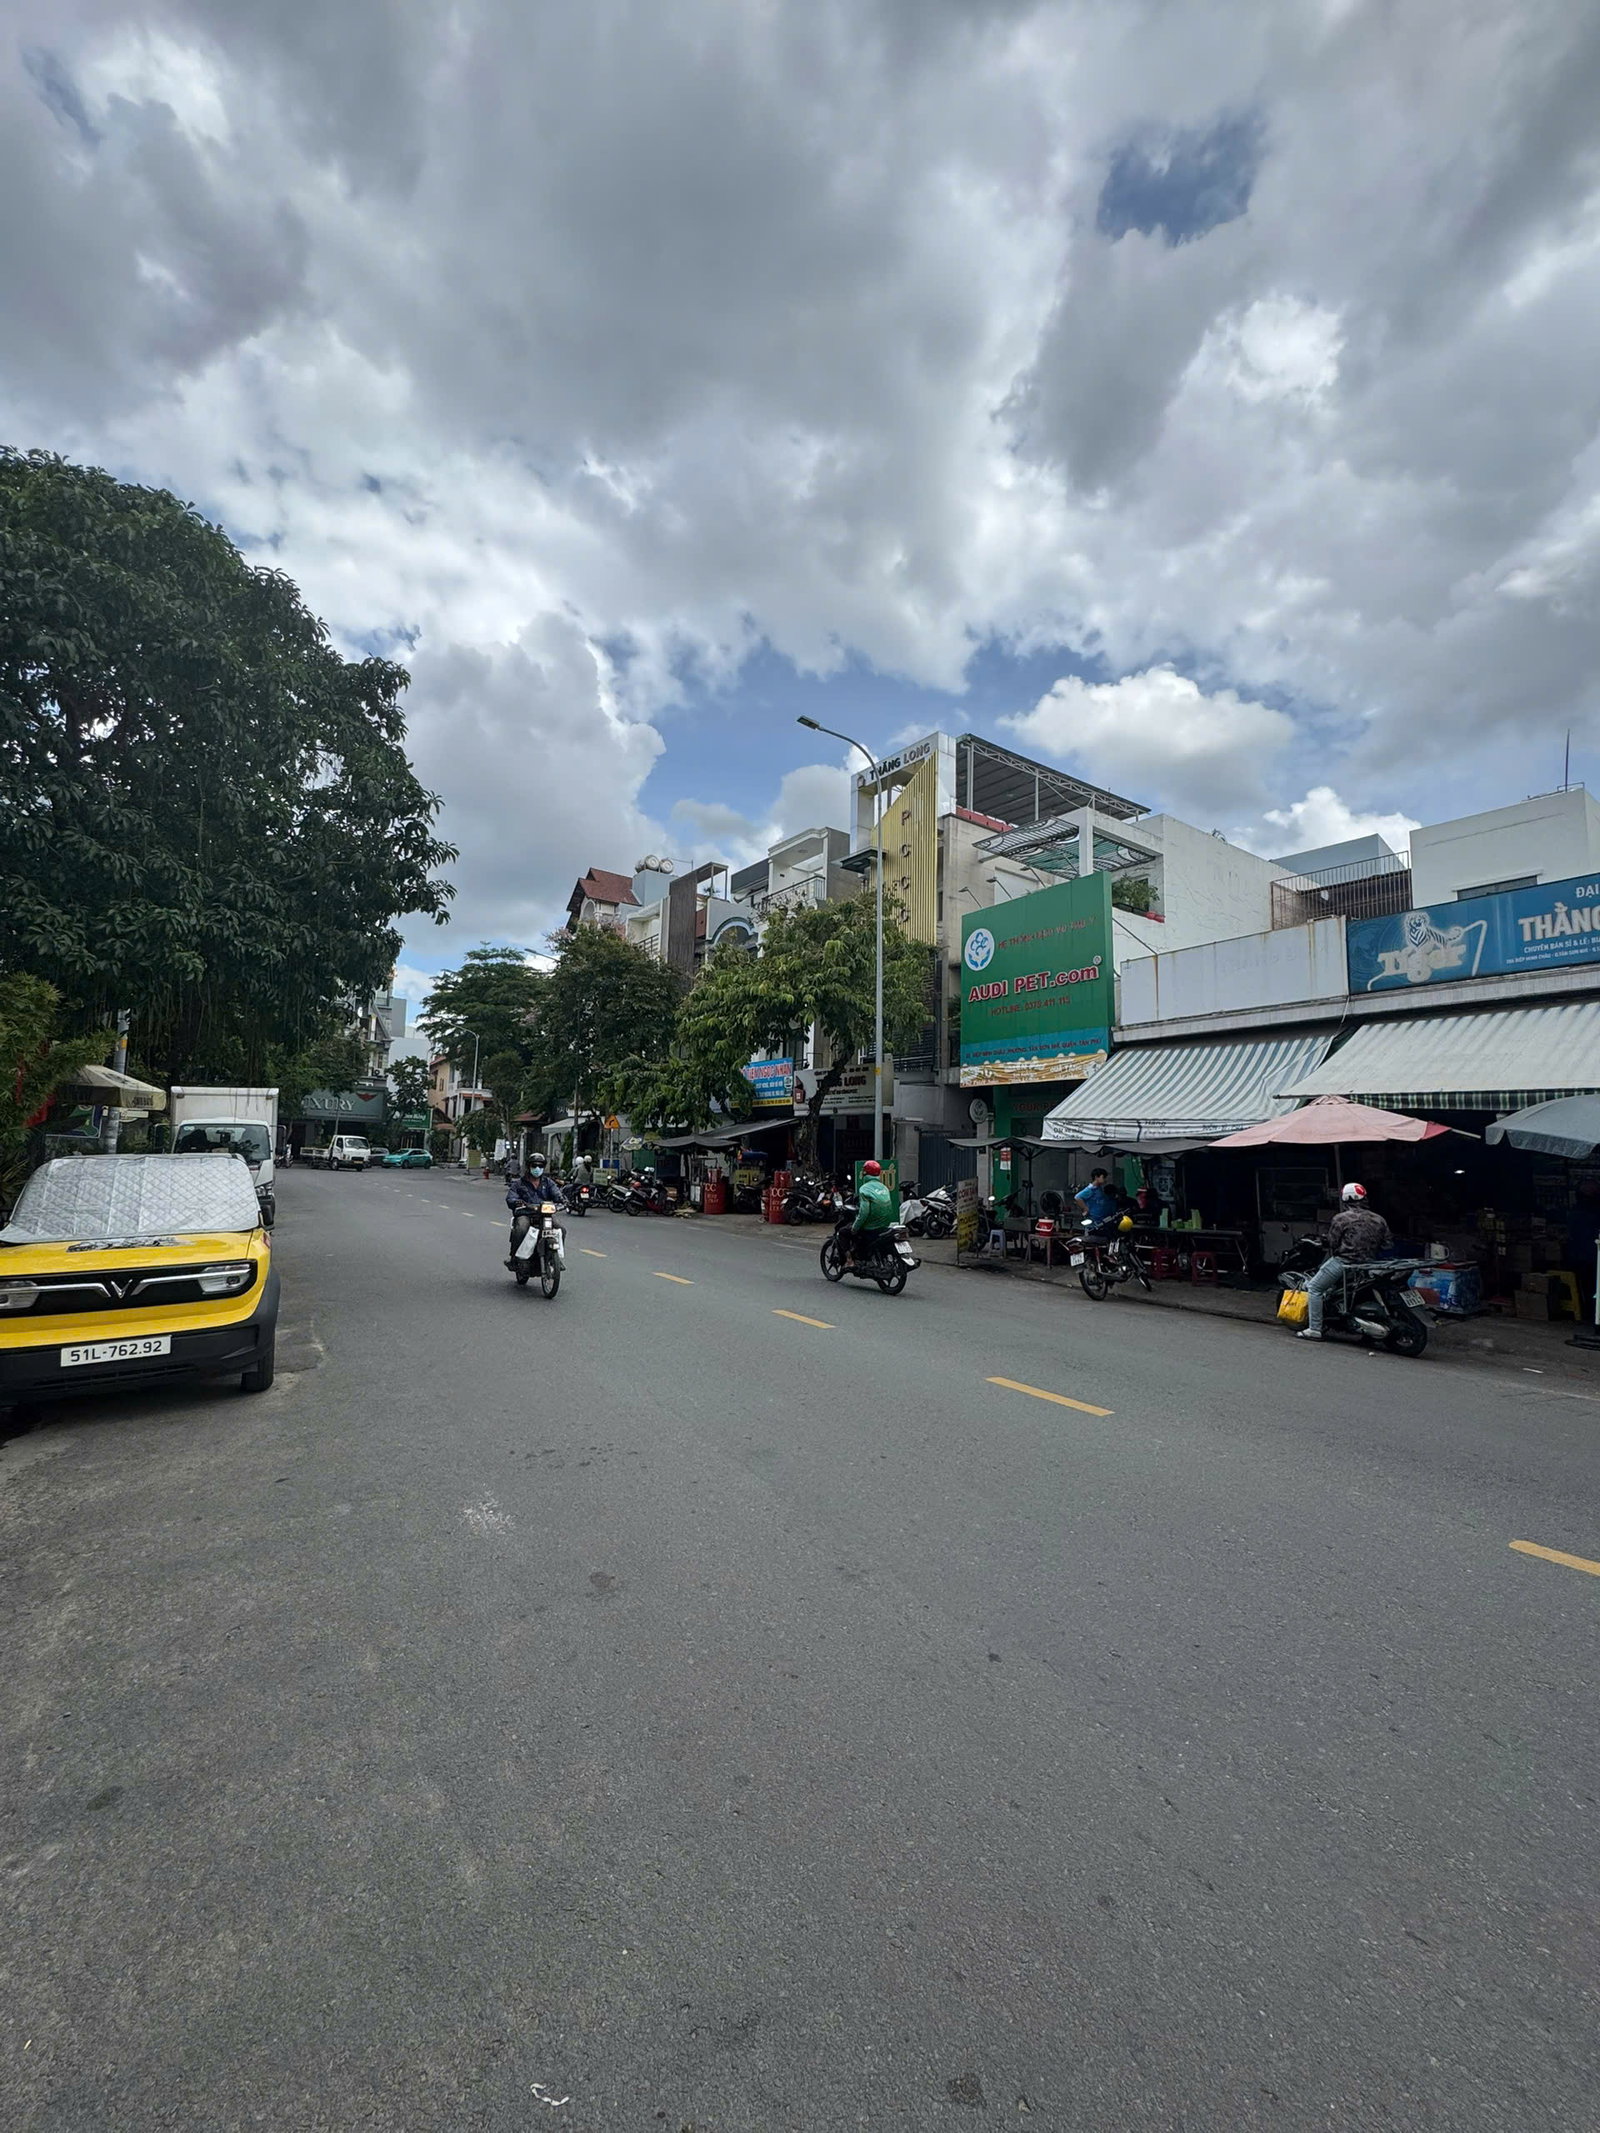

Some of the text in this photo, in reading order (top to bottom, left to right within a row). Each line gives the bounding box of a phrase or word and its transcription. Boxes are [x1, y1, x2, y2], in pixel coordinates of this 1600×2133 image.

[870, 742, 931, 780] THĂNG LONG
[969, 965, 1099, 1002] AUDI PET.com
[71, 1341, 162, 1362] 51L-762.92
